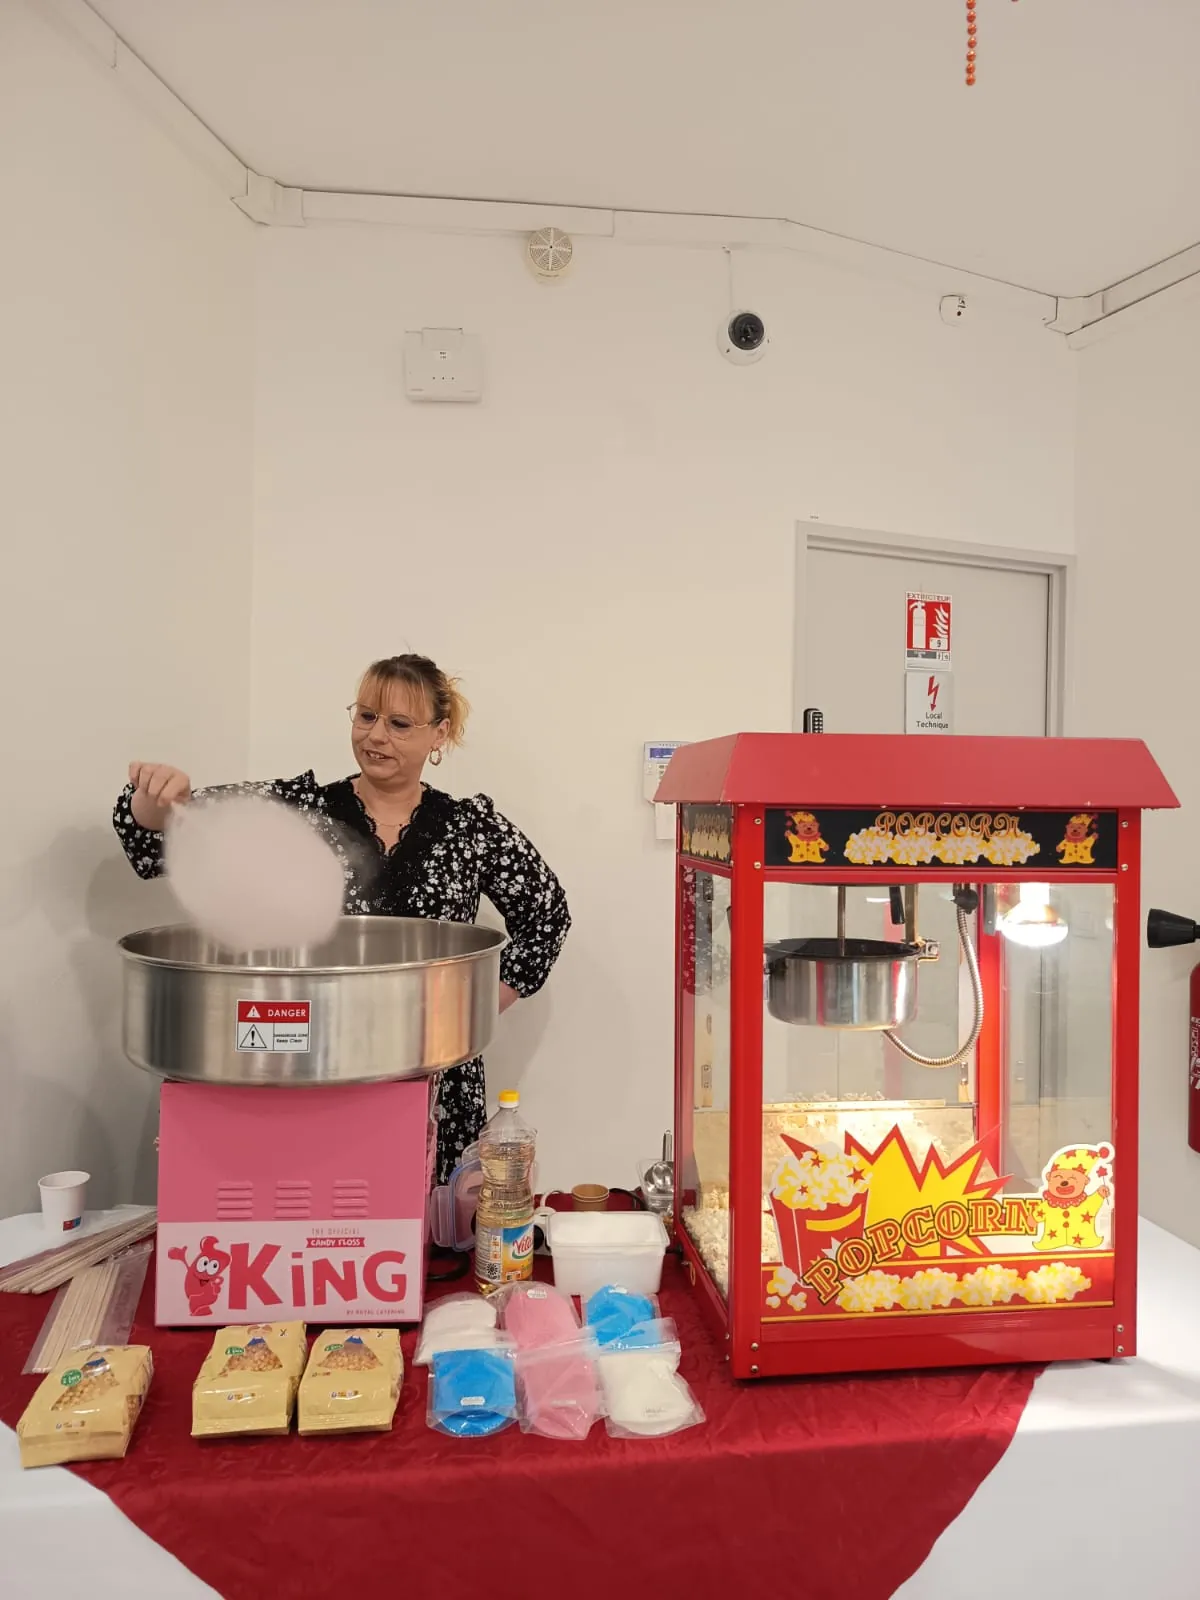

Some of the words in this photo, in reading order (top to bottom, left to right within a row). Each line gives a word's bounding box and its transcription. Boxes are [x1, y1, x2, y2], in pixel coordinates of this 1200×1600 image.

[907, 593, 951, 602] EXTINCTEUR
[925, 711, 943, 720] Local
[916, 721, 949, 730] Technique
[875, 811, 1021, 838] POPCORN
[267, 1008, 306, 1017] DANGER
[310, 1239, 336, 1247] CANDY
[338, 1239, 361, 1247] FLOSS
[803, 1197, 1042, 1304] POPCORN
